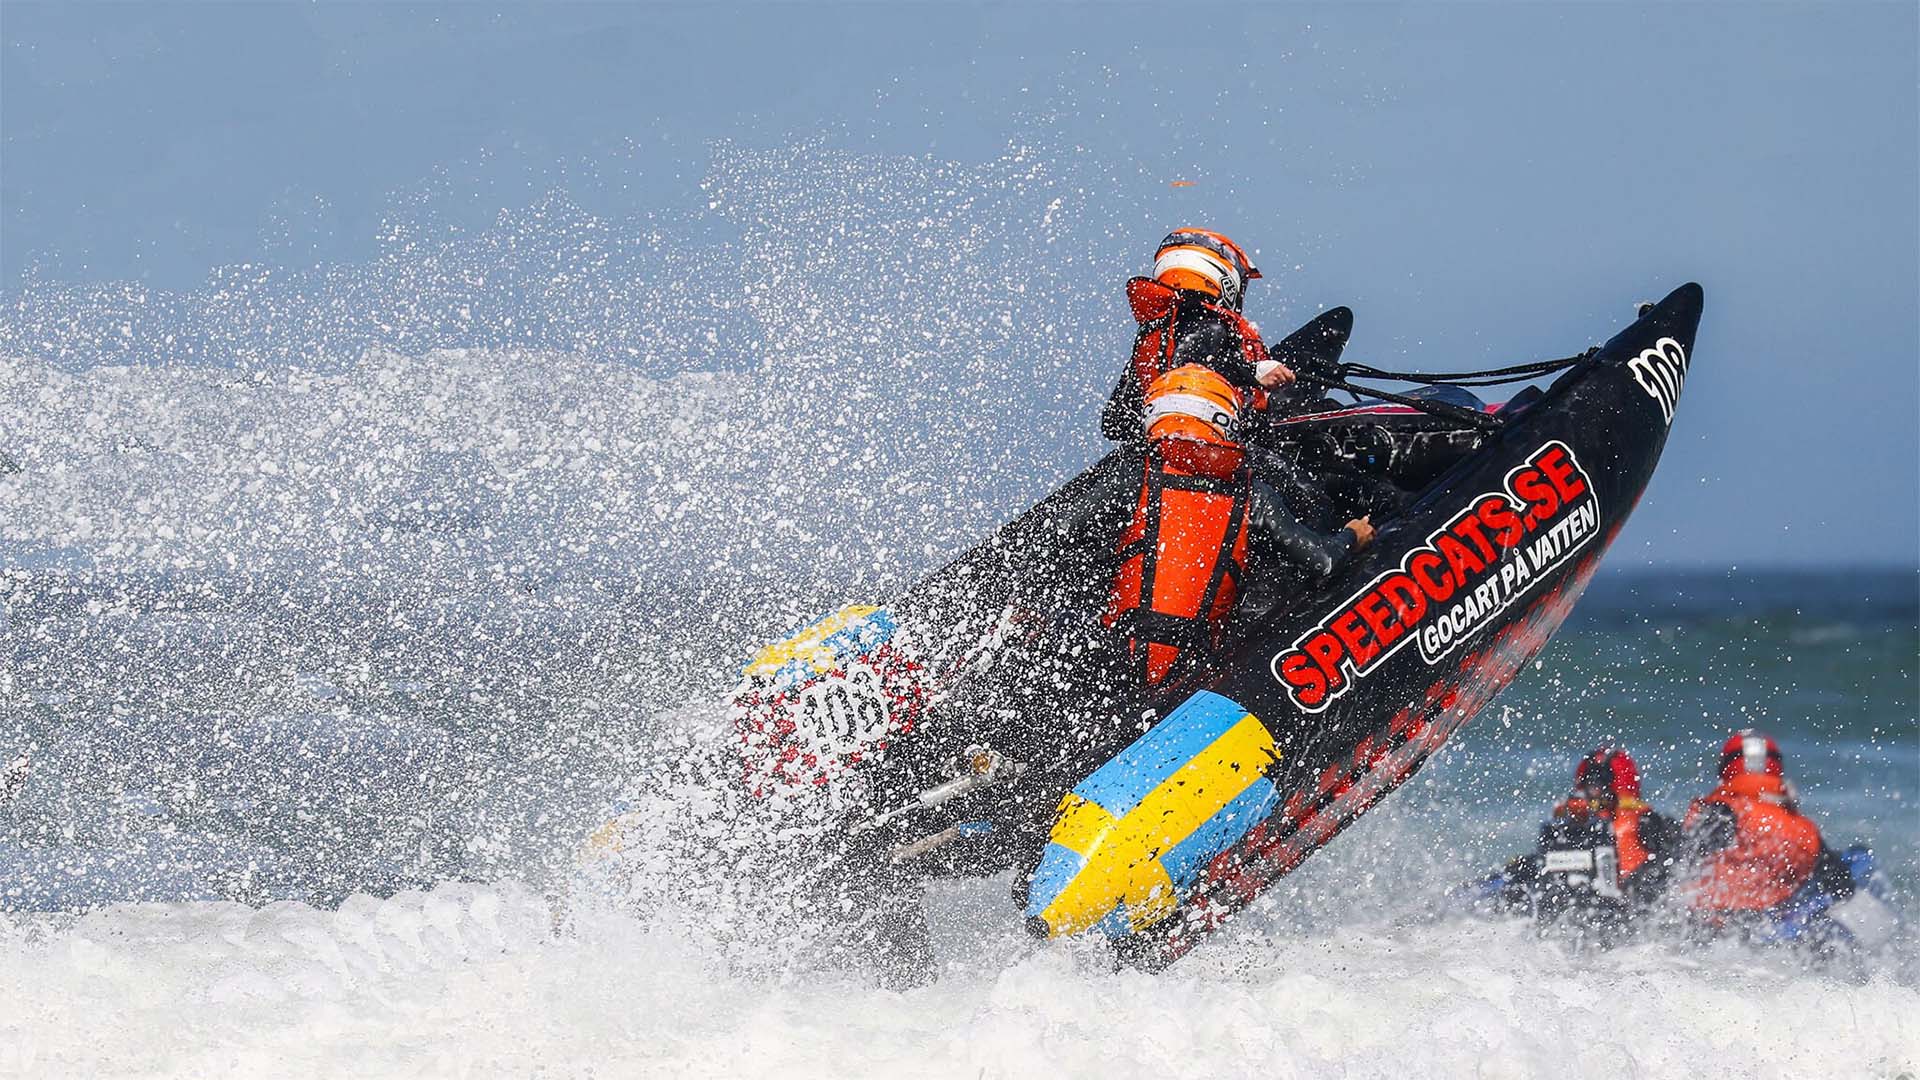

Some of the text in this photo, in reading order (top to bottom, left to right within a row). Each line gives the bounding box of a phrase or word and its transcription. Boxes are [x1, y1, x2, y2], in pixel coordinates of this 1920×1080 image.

[1281, 447, 1586, 704] SPEEDCATS.SE
[1424, 500, 1595, 654] GOCART PÅ VATTEN
[801, 665, 887, 756] 108
